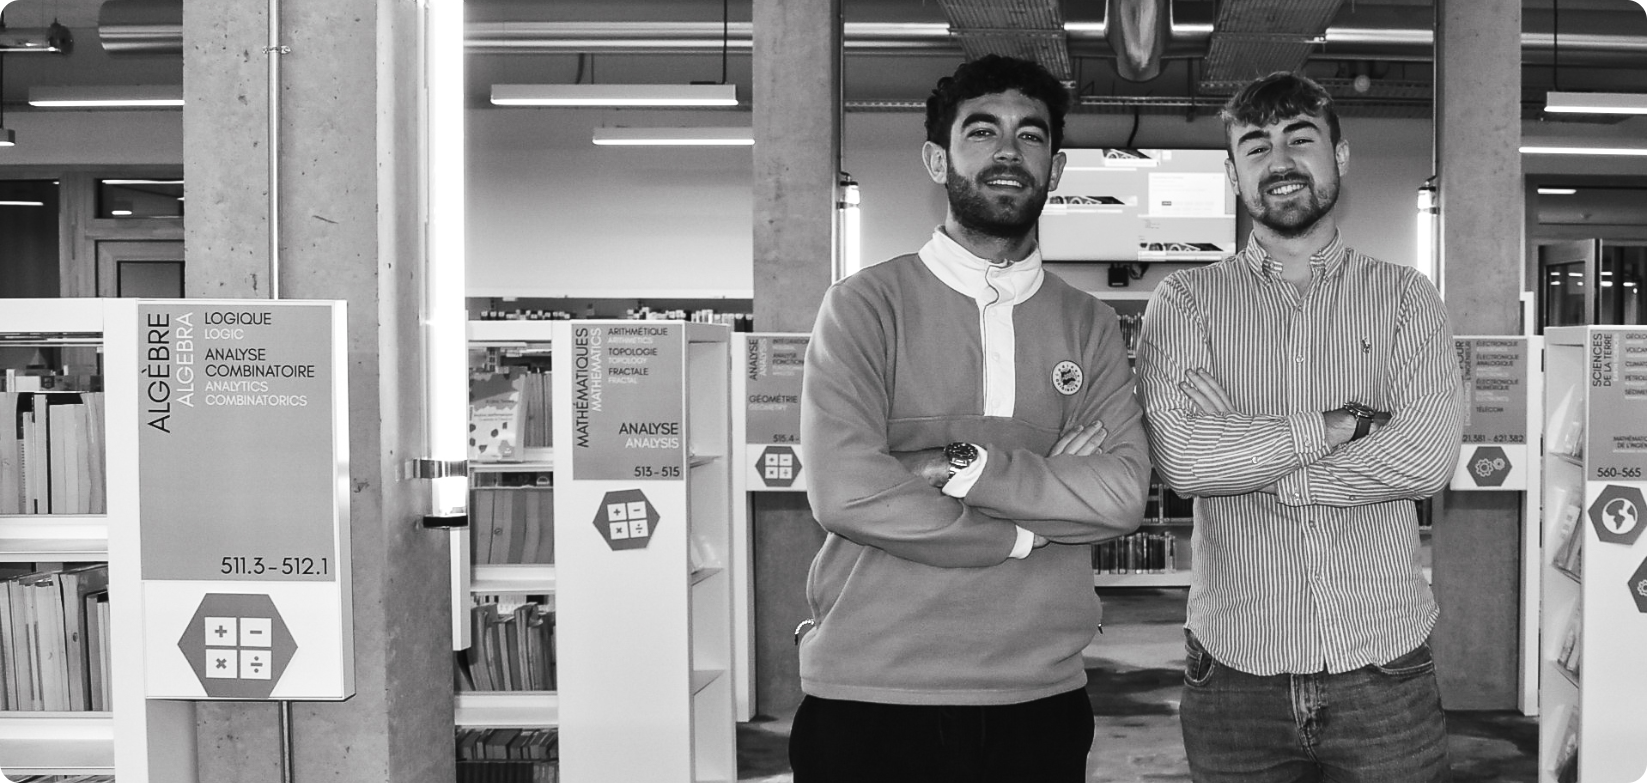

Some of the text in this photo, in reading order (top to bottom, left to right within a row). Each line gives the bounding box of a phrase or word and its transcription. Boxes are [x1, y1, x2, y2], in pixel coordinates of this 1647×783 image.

[205, 312, 271, 325] LOGIQUE
[205, 329, 243, 339] LOGIC
[608, 327, 667, 335] ARITHMÉTIQUE
[205, 348, 265, 361] ANALYSE
[609, 348, 657, 356] TOPOLOGIE
[176, 312, 193, 407] ALGEBRA
[749, 340, 758, 380] ANALYSE
[1593, 334, 1602, 387] SCIENCES
[1603, 334, 1612, 386] DE LA TERRE
[142, 314, 170, 433] ALGÈBRE
[206, 364, 314, 377] COMBINATOIRE
[590, 328, 602, 411] MATHEMATICS
[205, 381, 268, 392] ANALYTICS
[573, 328, 589, 447] MATHÉMATIQUES
[206, 395, 307, 406] COMBINATORICS
[749, 394, 797, 403] GÉOMÉTRIE
[619, 423, 678, 435] ANALYSE
[626, 438, 679, 448] ANALYSIS
[1598, 467, 1641, 477] 560-565
